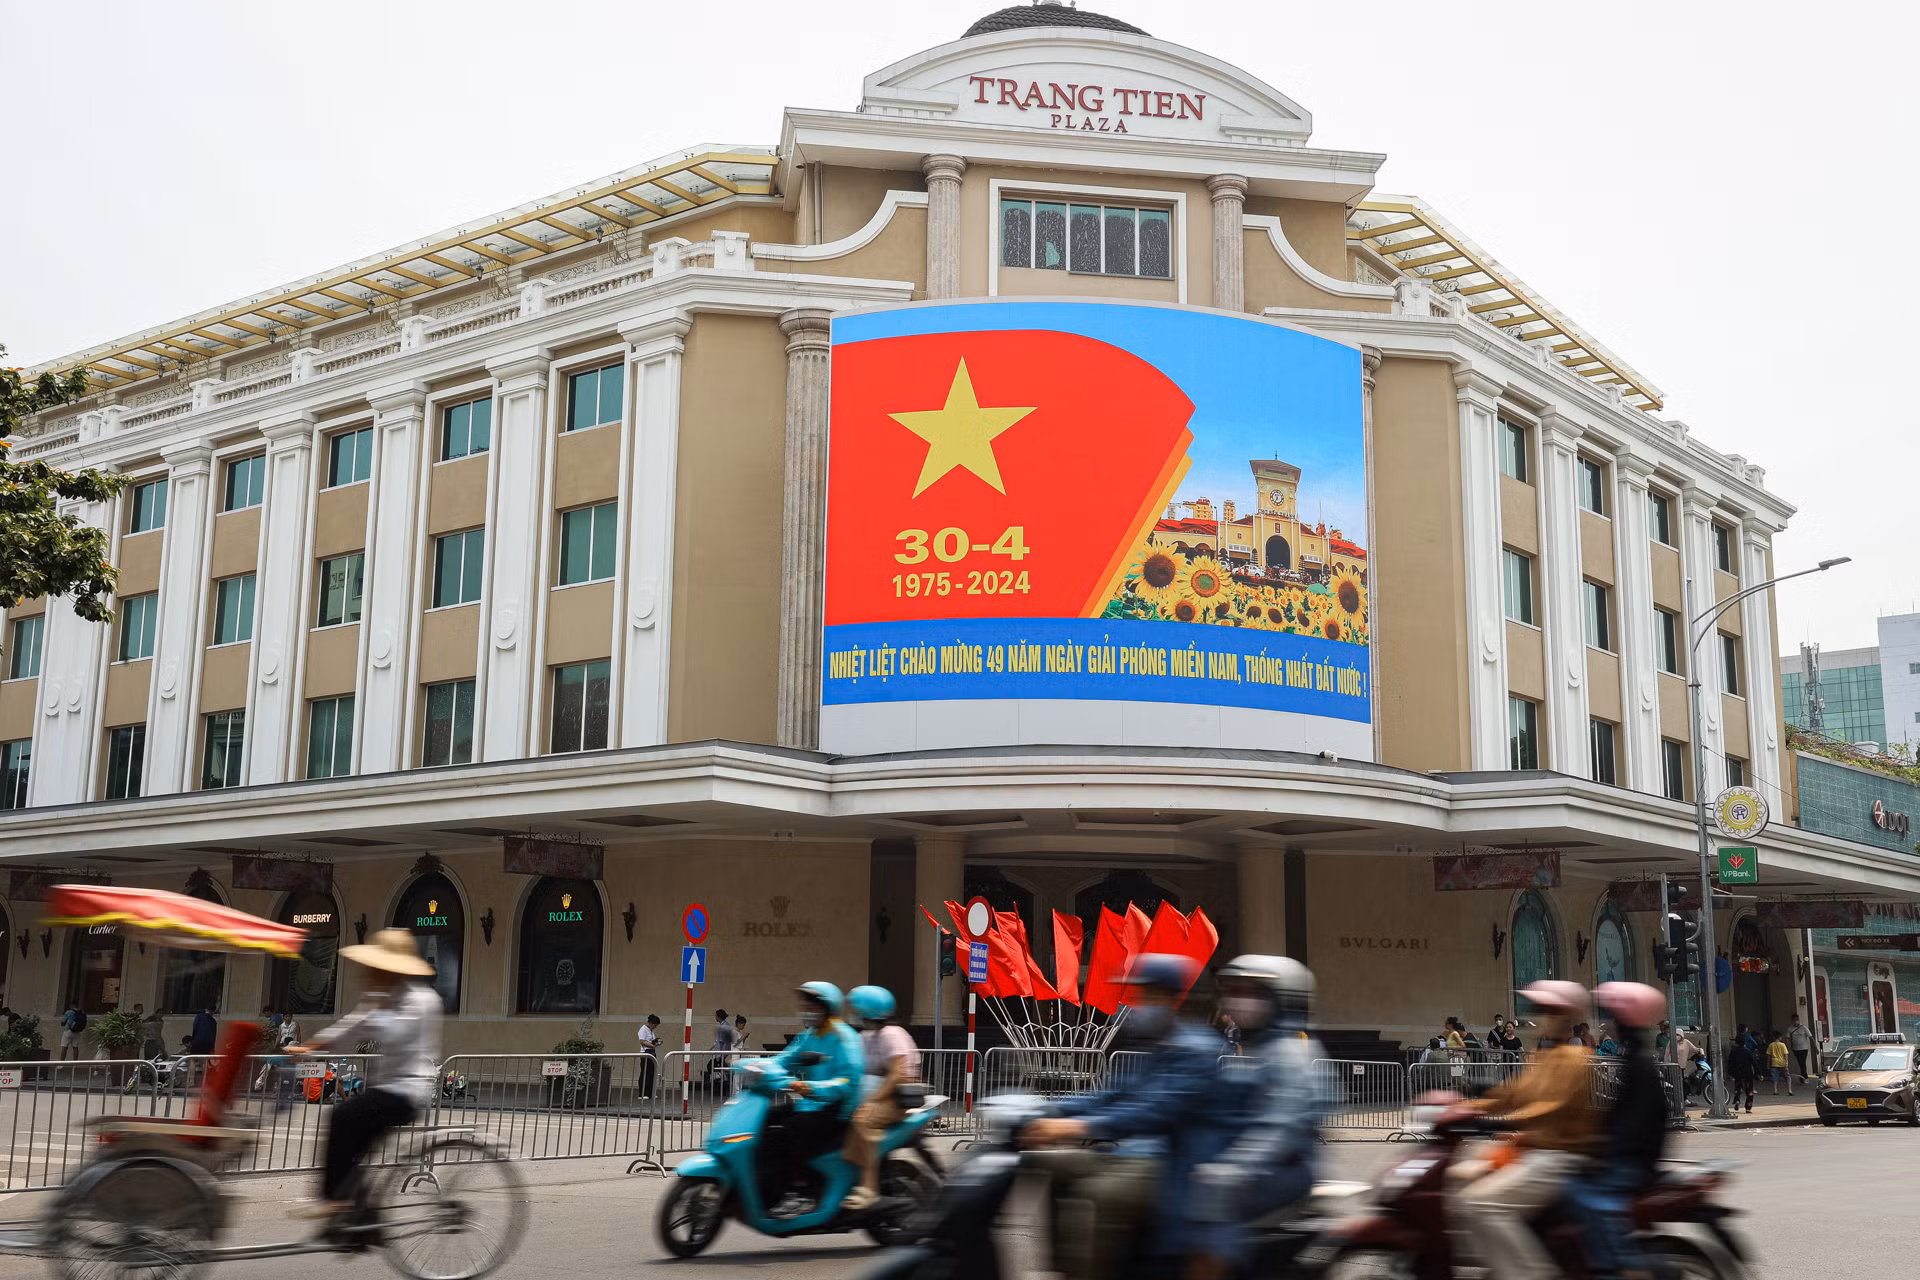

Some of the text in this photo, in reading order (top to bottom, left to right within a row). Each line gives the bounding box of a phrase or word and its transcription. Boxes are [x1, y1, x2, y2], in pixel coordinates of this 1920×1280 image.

[969, 75, 1206, 121] TRANG TIEN
[1051, 113, 1128, 133] PLAZA
[894, 526, 1031, 564] 30-4
[829, 644, 866, 684] NHIỆT
[869, 642, 897, 683] LIỆT
[900, 640, 937, 676] CHÀO
[940, 638, 983, 674] MỪNG
[986, 645, 1004, 673] 49
[1007, 639, 1041, 674] NĂM
[1045, 639, 1084, 674] NGÀY
[1087, 634, 1116, 675] GIẢI
[1120, 641, 1167, 676] PHÓNG
[1170, 640, 1205, 679] MIỀN
[1208, 651, 1242, 685] NAM,
[1244, 647, 1283, 686] THỐNG
[1285, 652, 1314, 689] NHẤT
[1316, 656, 1335, 692] ĐẤT
[293, 913, 332, 924] BURBERRY
[416, 916, 448, 927] ROLEX
[548, 911, 583, 922] ROLEX
[88, 924, 118, 935] Cartier
[1340, 936, 1429, 950] BVLGARI
